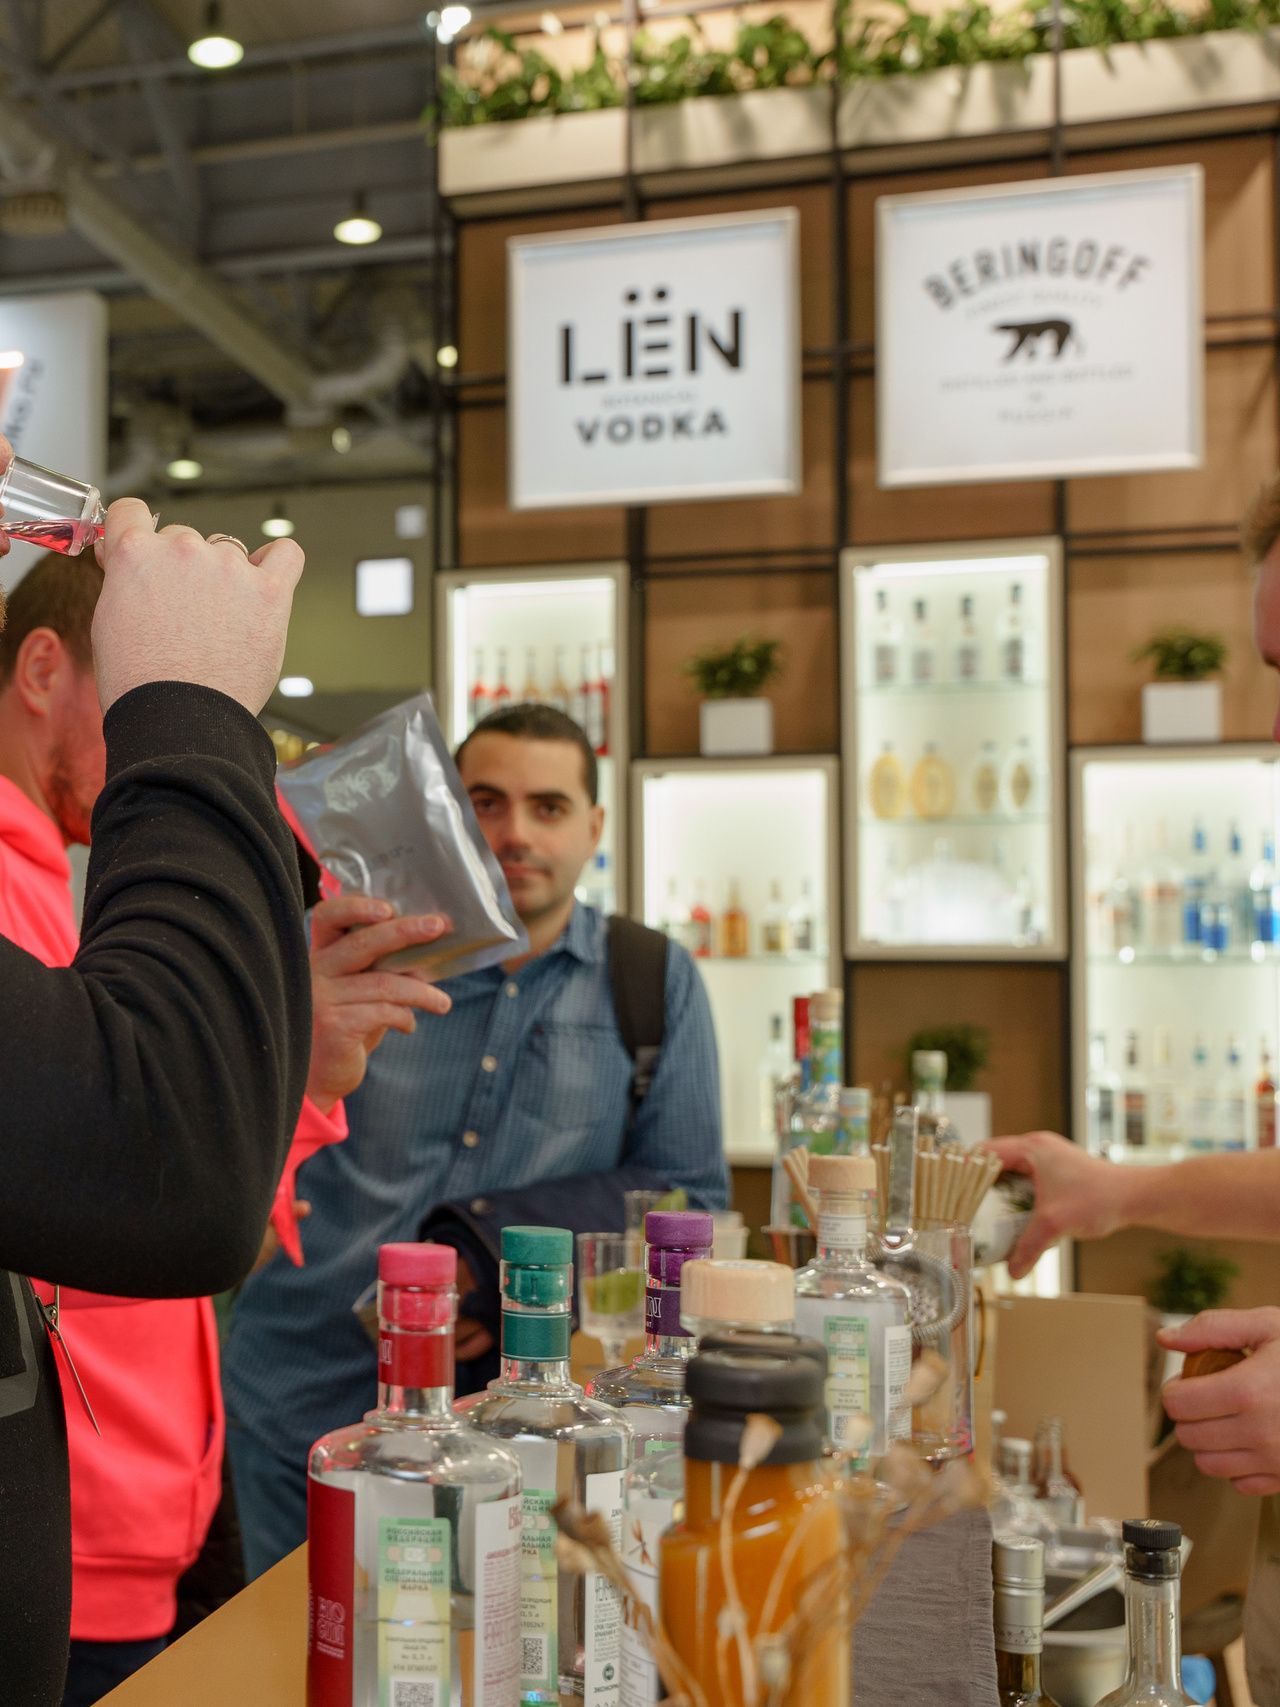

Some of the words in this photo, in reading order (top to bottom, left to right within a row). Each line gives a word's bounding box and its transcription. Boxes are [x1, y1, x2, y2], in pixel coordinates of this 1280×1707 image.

[923, 234, 1154, 312] BERINGOFF
[558, 285, 743, 387] LËN
[576, 409, 728, 445] VODKA
